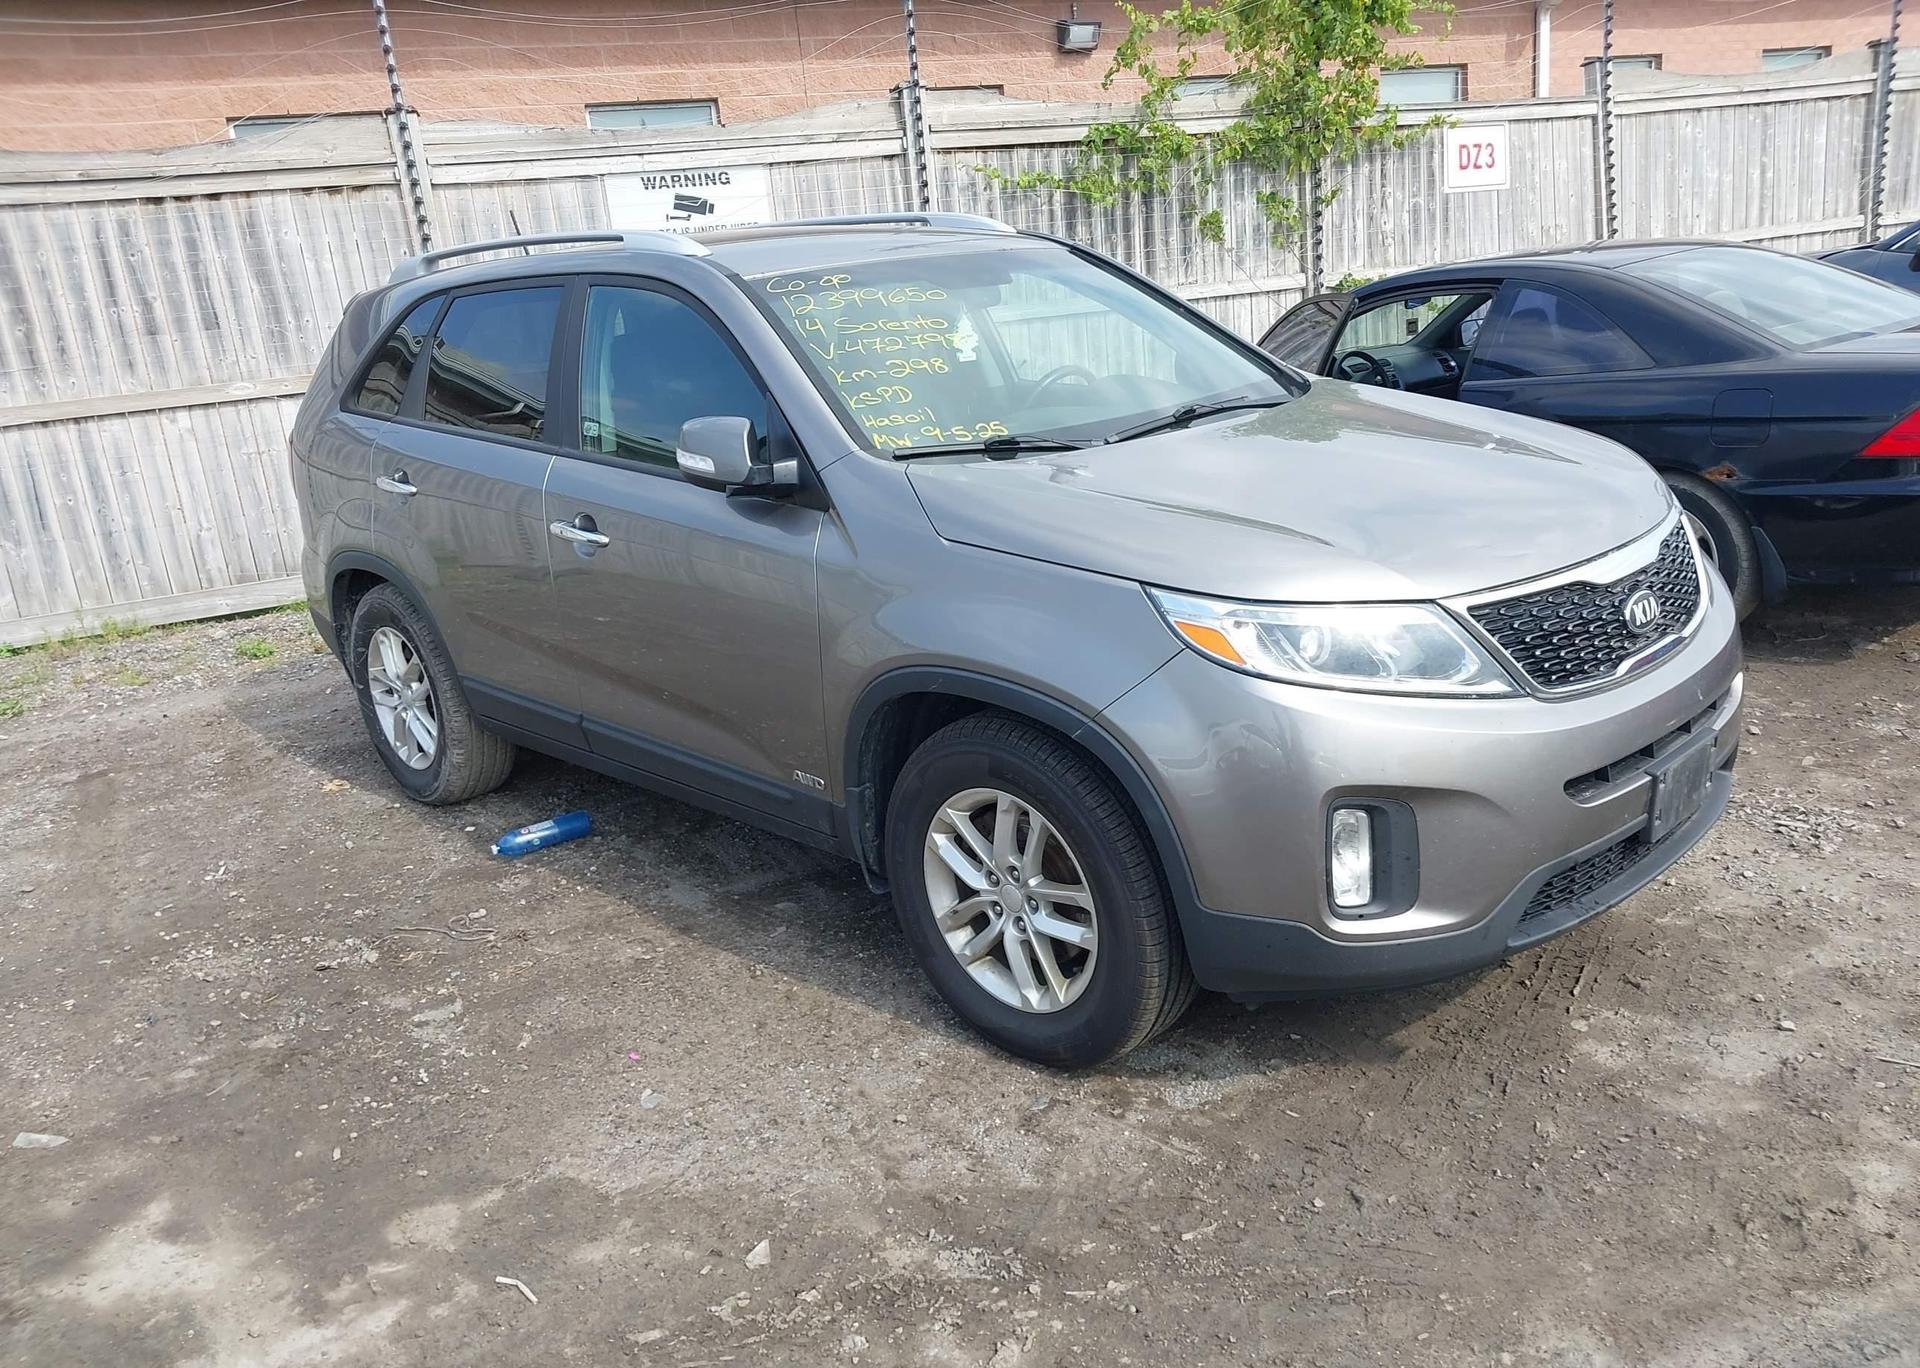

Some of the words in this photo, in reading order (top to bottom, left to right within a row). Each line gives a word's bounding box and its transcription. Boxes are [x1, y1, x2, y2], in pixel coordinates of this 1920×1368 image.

[1458, 142, 1496, 171] DZ3
[640, 171, 731, 190] WARNING
[782, 287, 948, 318] 12399650
[794, 317, 828, 339] 14
[833, 313, 949, 334] Sorento
[1632, 596, 1658, 627] KIA
[792, 769, 825, 790] AWD
